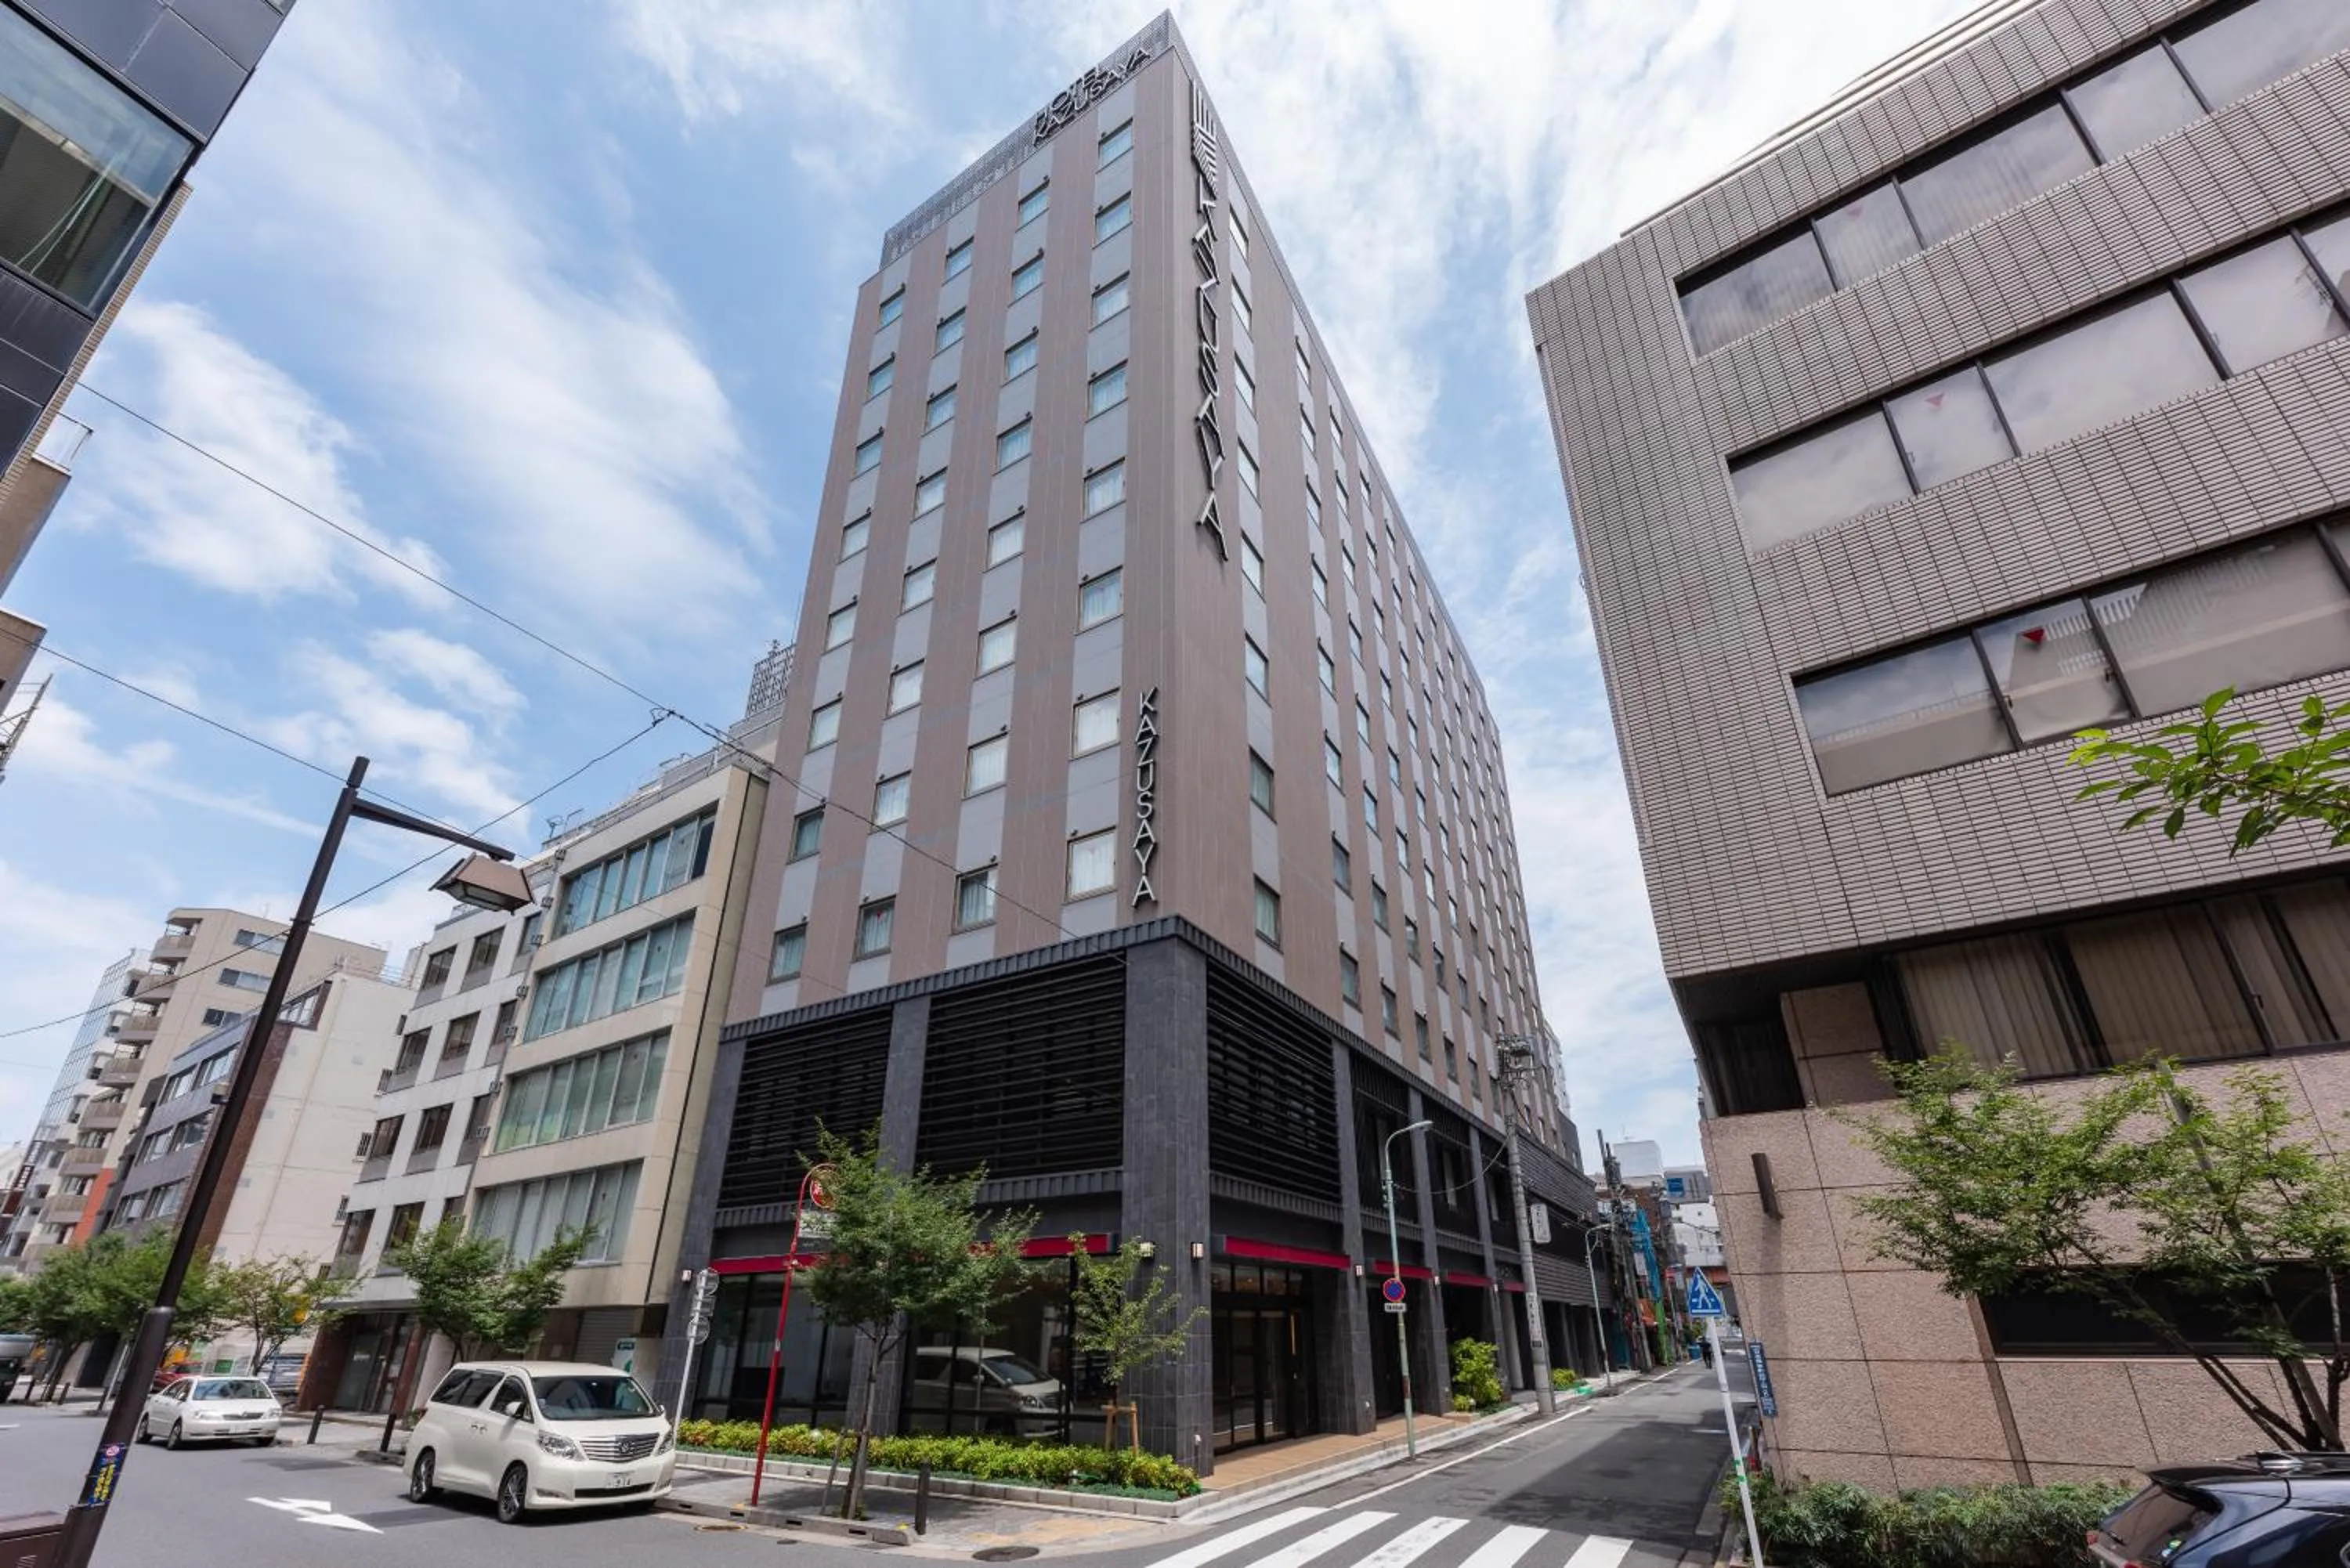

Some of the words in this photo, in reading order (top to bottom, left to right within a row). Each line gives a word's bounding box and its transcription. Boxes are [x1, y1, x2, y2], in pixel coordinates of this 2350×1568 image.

[1033, 48, 1151, 147] KAZUSAYA
[1191, 174, 1229, 562] KAZUSAYA
[1133, 686, 1158, 907] KAZUSAYA
